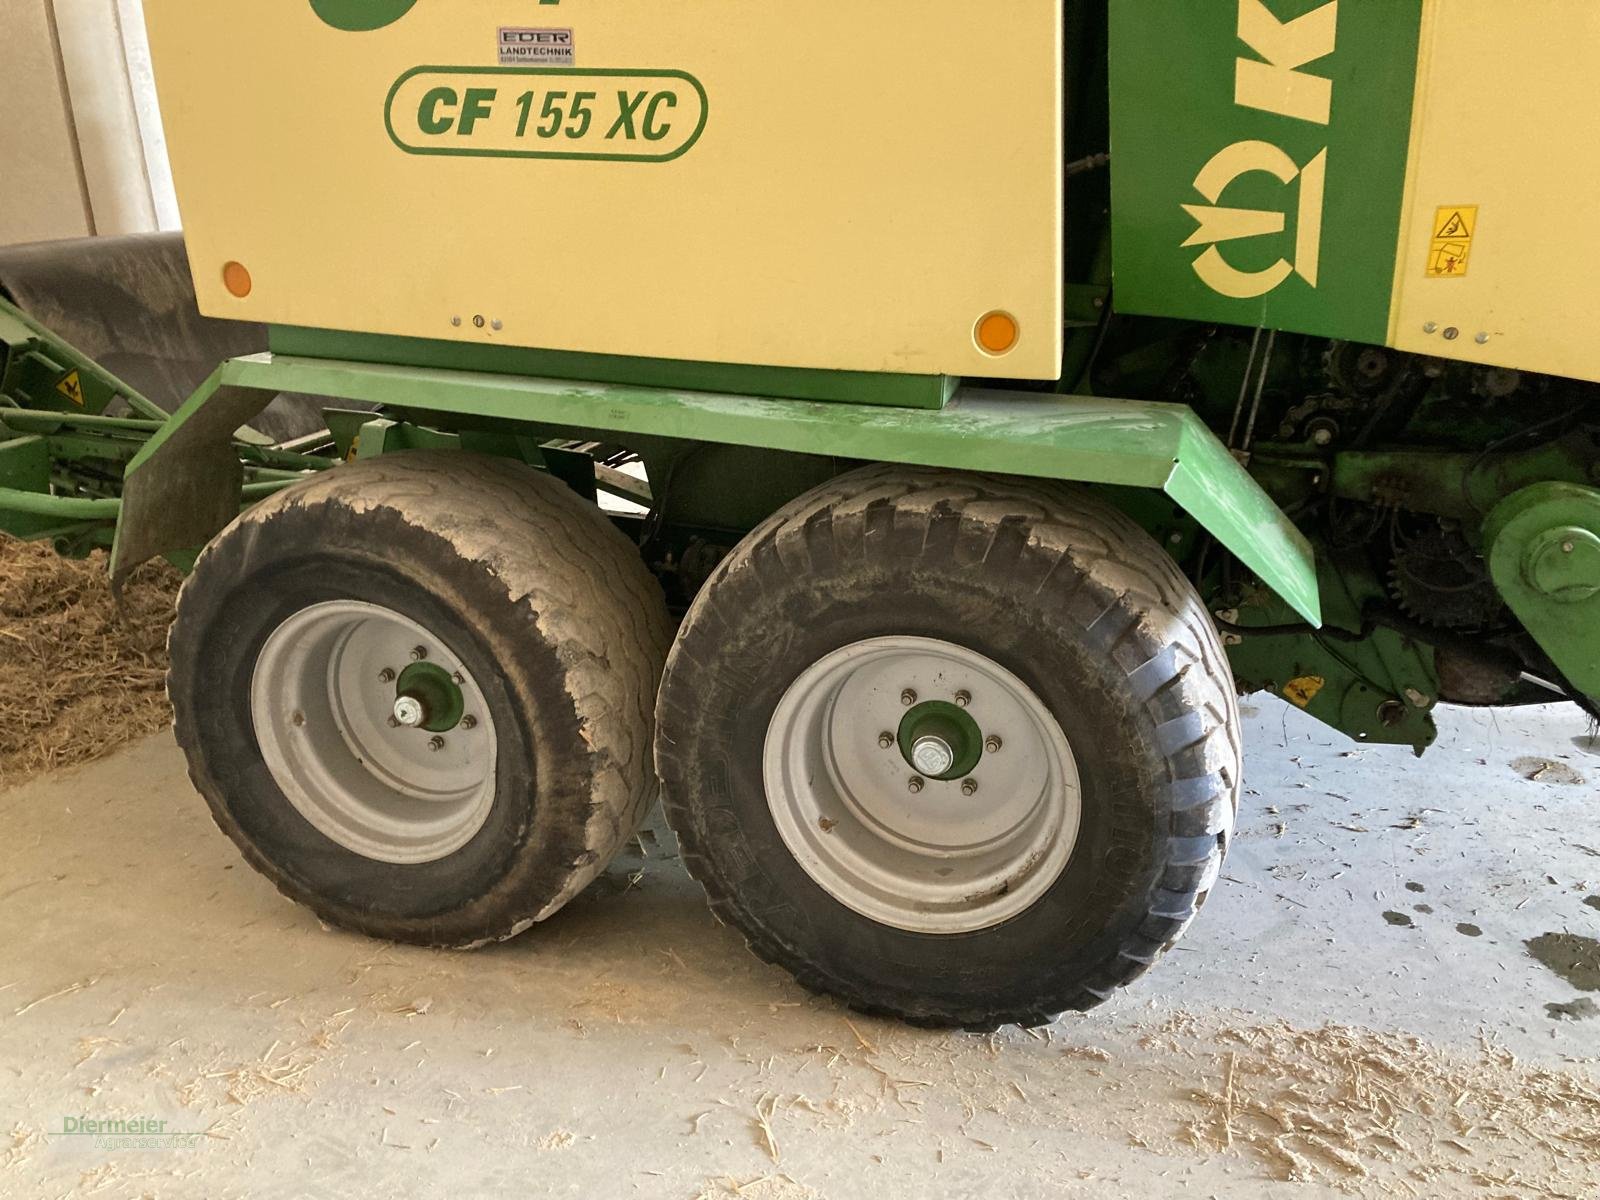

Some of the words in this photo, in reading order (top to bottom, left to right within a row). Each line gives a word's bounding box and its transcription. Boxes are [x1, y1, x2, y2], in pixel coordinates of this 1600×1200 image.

[503, 32, 569, 43] EDER
[500, 47, 572, 56] LANDTECHNIK
[417, 87, 498, 135] CF
[515, 91, 596, 139] 155
[605, 91, 677, 141] XC
